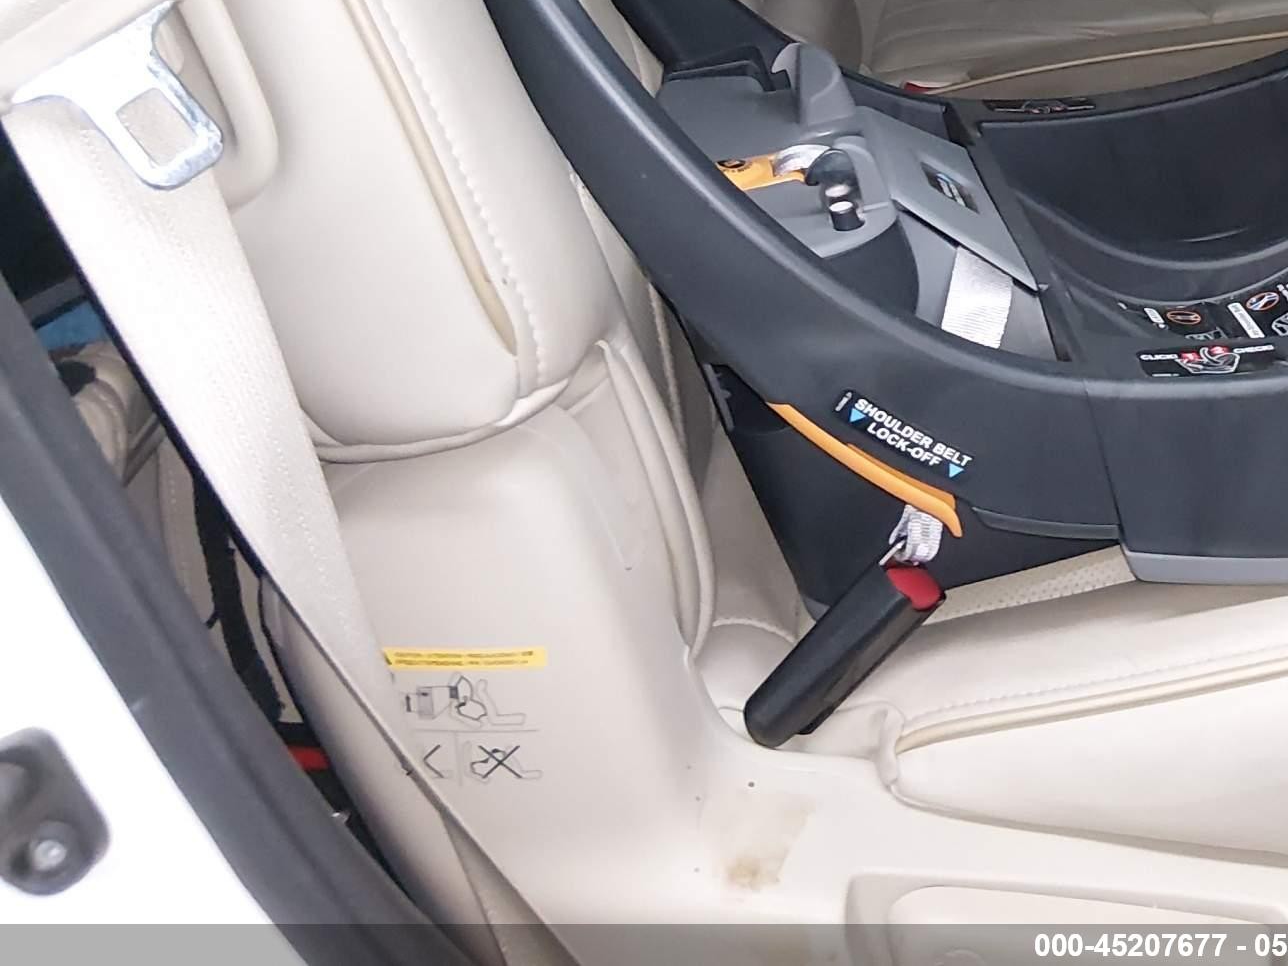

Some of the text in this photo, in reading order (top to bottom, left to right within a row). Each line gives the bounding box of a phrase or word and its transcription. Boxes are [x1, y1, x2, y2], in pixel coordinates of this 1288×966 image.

[854, 398, 973, 467] SHOULDER BELT
[866, 422, 943, 466] LOCK-OFF
